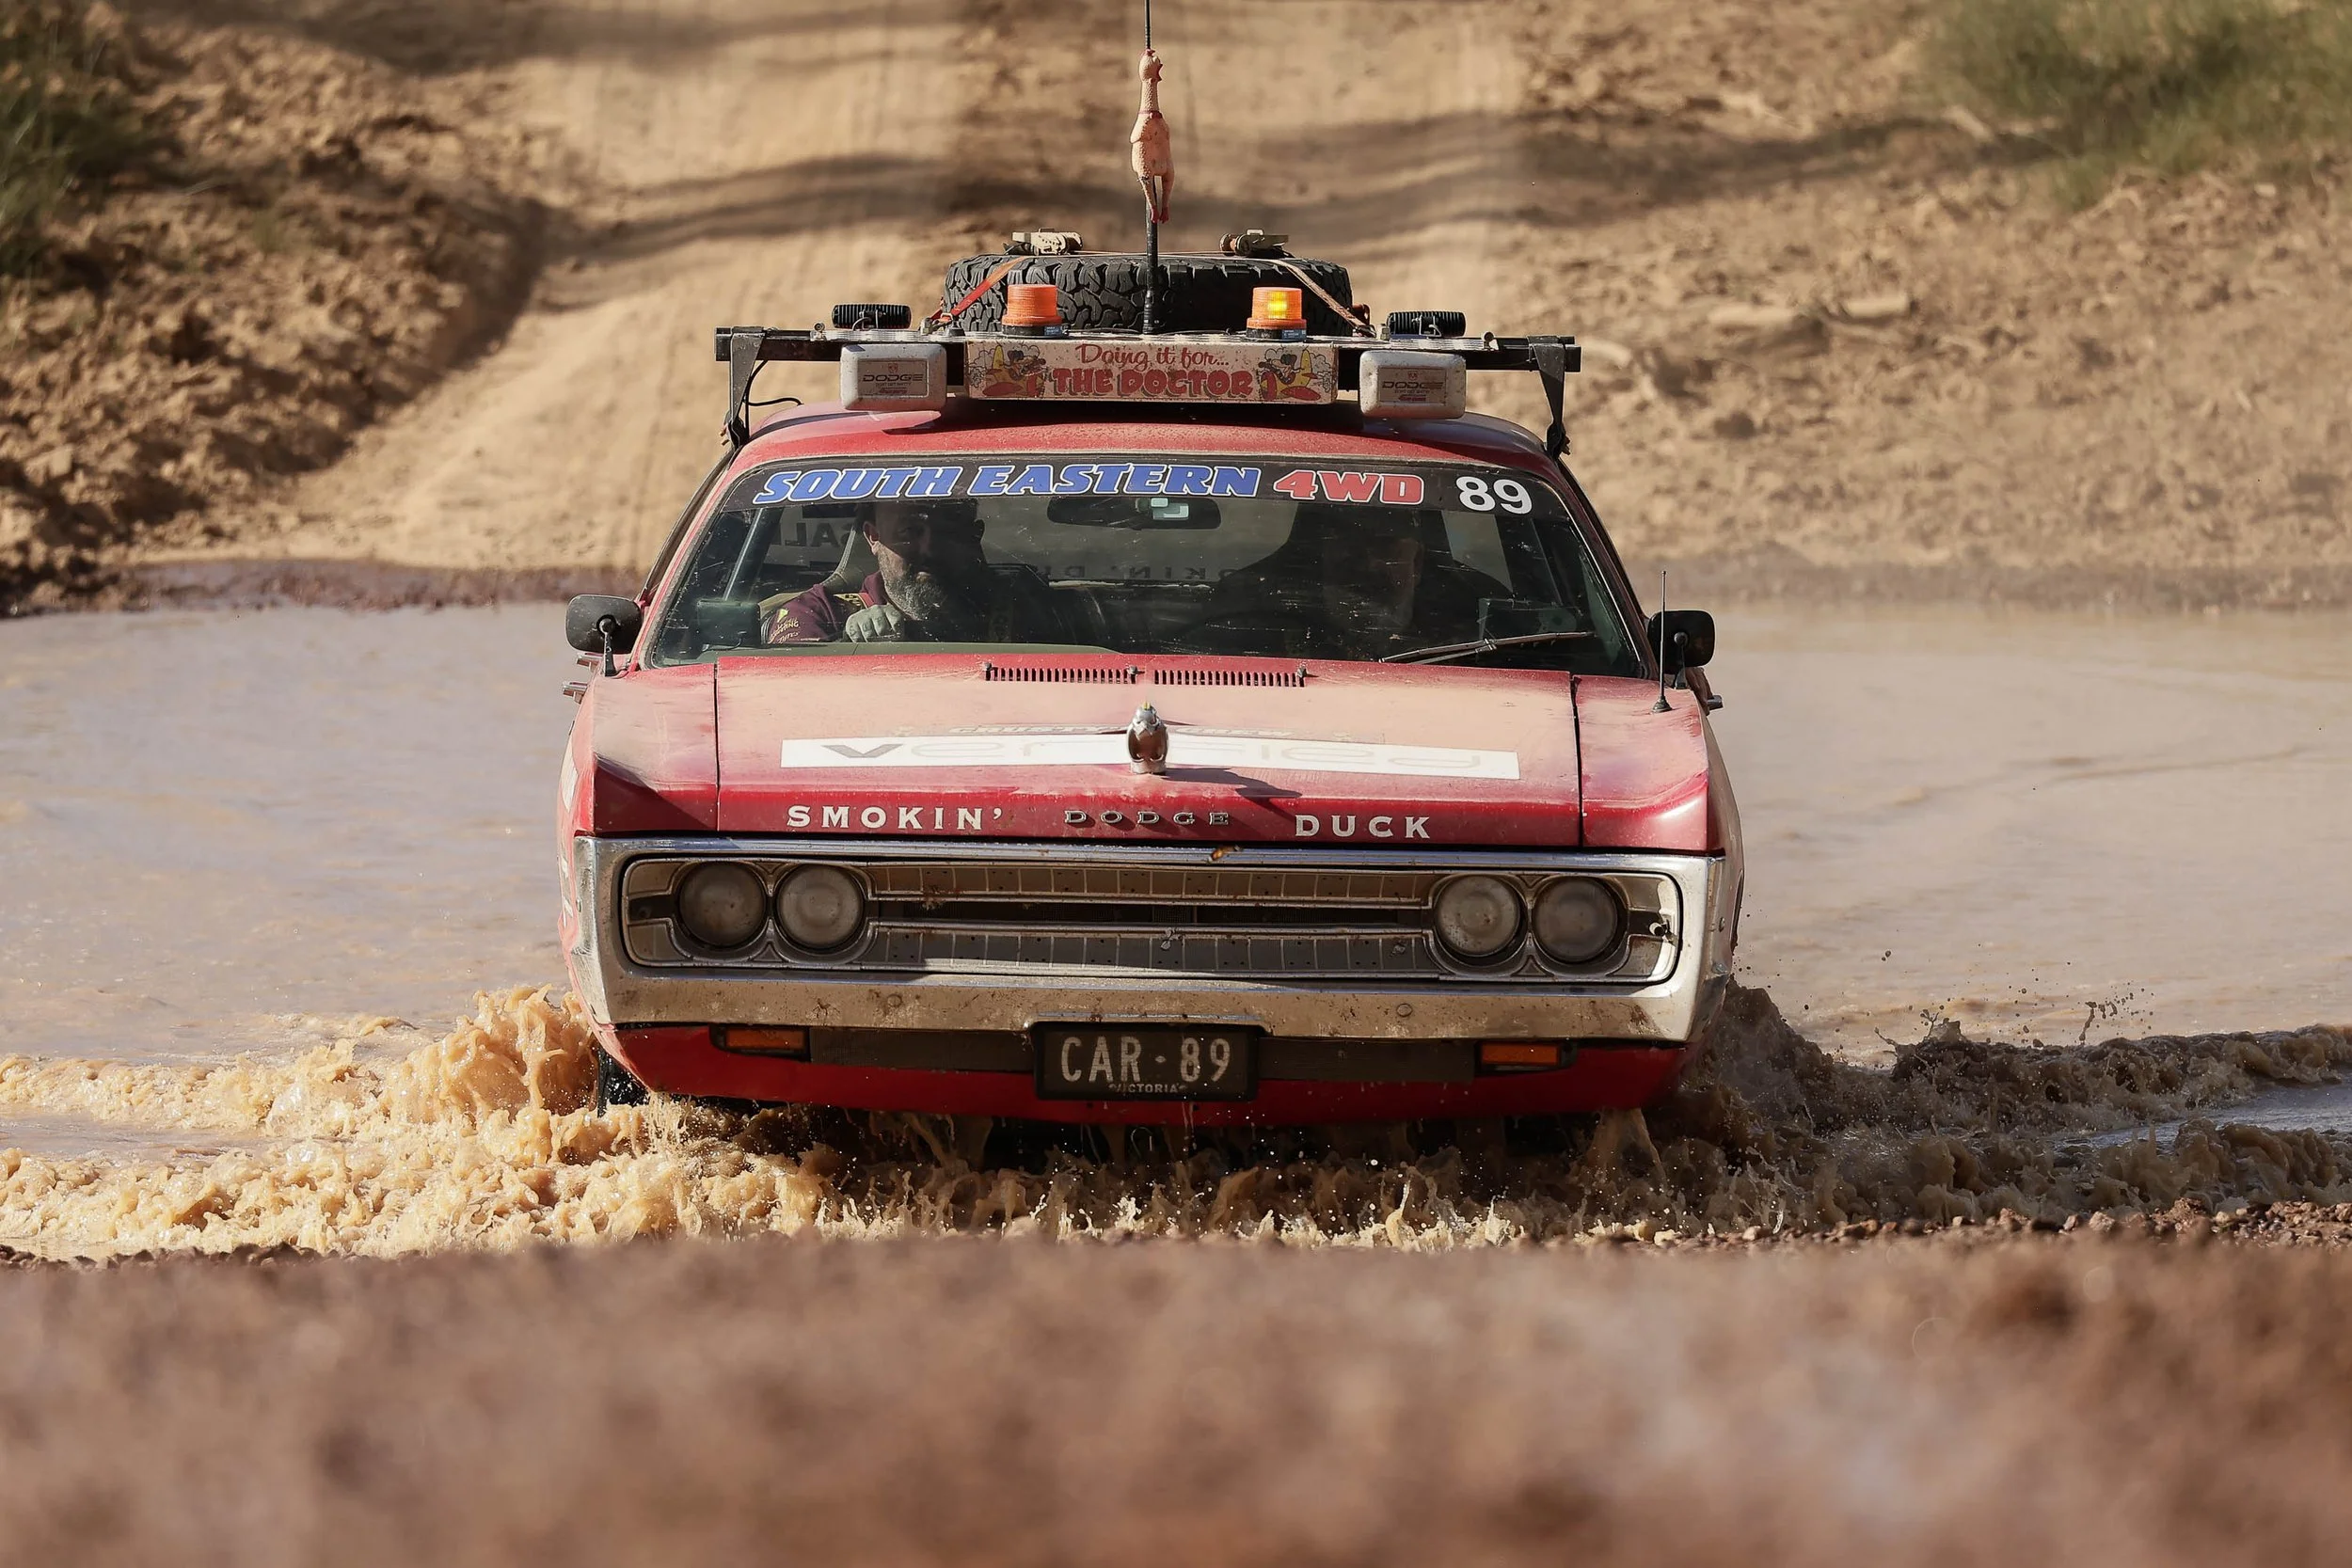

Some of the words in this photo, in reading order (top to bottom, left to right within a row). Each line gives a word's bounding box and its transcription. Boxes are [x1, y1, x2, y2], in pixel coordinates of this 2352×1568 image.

[1074, 343, 1149, 372] Doing
[1156, 346, 1176, 365] it
[1181, 346, 1230, 369] for...
[862, 373, 924, 382] DODGE
[1051, 368, 1114, 395] THE
[1119, 369, 1254, 397] DOCTOR
[753, 466, 963, 504] SOUTH
[967, 463, 1262, 498] EASTERN
[1273, 469, 1424, 505] 4WD
[1455, 476, 1533, 515] 89
[787, 804, 1003, 832] SMOKIN'
[1063, 809, 1230, 826] DODGE
[1295, 814, 1432, 839] DUCK
